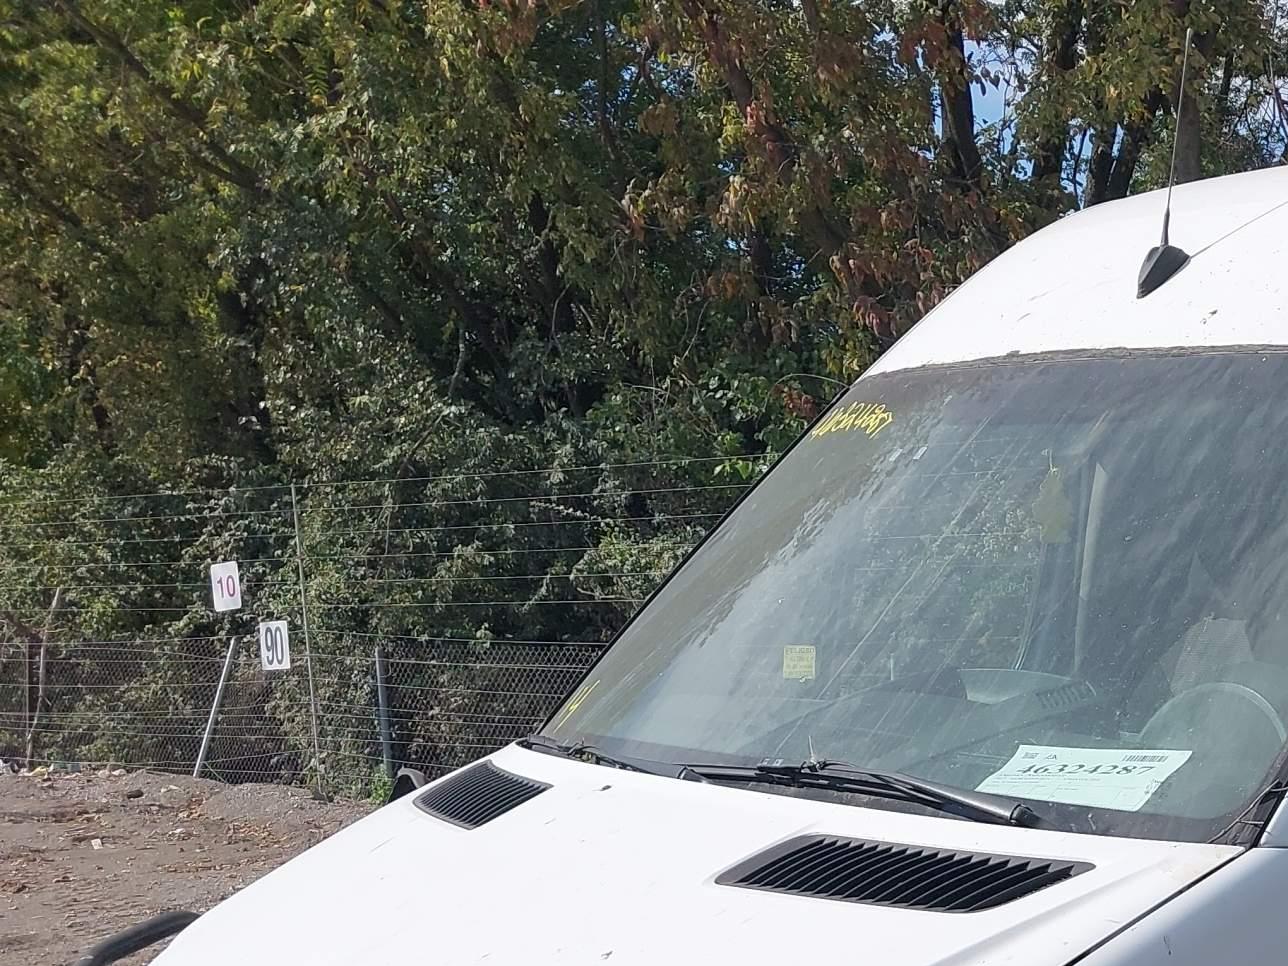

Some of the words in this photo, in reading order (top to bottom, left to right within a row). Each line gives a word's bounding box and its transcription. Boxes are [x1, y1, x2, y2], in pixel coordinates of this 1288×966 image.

[217, 575, 236, 598] 10
[264, 626, 285, 666] 90
[1016, 763, 1155, 776] 46324287
